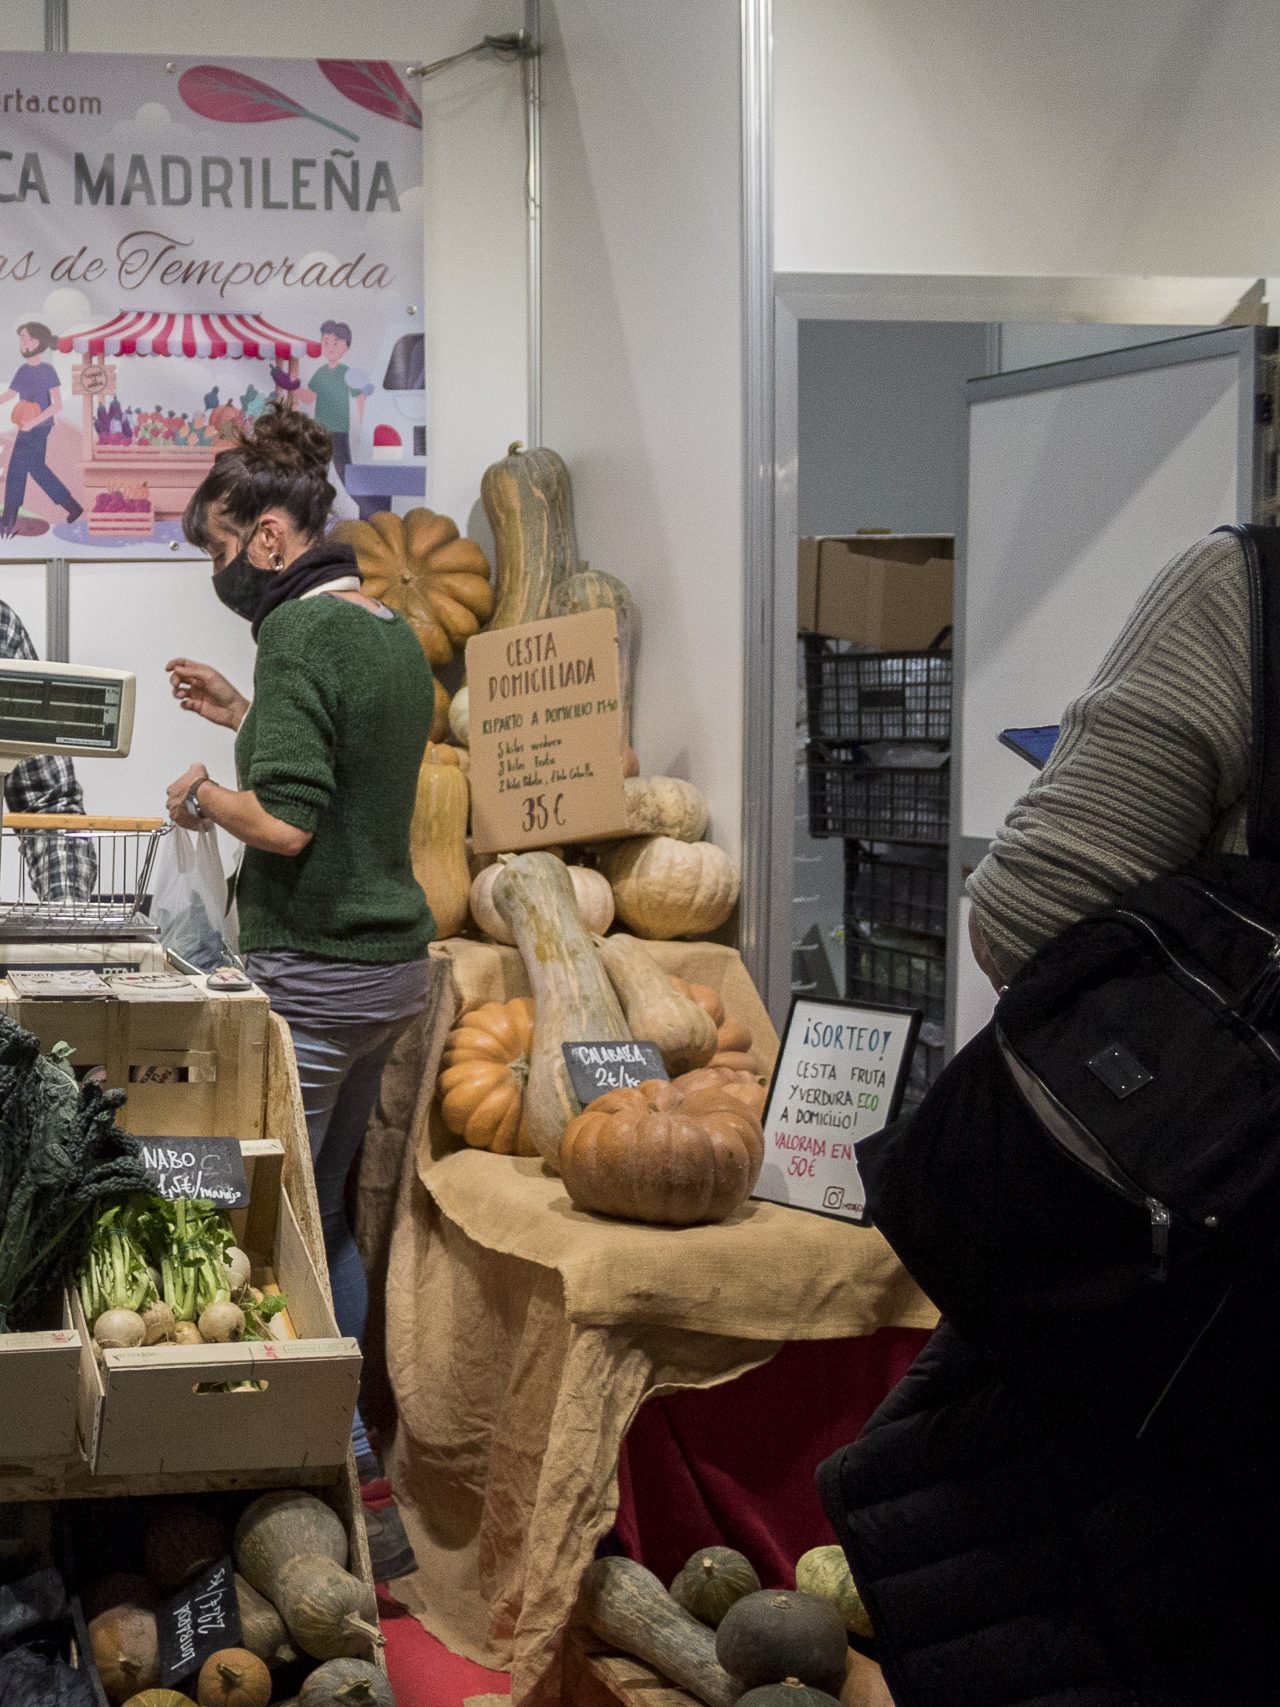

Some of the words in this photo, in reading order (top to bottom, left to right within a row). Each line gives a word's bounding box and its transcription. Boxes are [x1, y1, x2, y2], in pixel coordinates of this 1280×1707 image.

[73, 148, 401, 214] MADRILEÑA
[50, 240, 107, 284] de
[116, 230, 398, 299] Temporada
[506, 632, 557, 667] CESTA
[489, 658, 596, 702] DOMICILIADA
[803, 1017, 893, 1062] ¡SORTEO!
[578, 1044, 647, 1066] CALABAZA
[797, 1060, 837, 1081] CESTA
[851, 1066, 887, 1088] FRUTA
[780, 1109, 790, 1124] A
[857, 1092, 880, 1112] ECO
[142, 1146, 196, 1170] NABO
[774, 1131, 827, 1157] VALORADA
[830, 1143, 853, 1161] EN
[787, 1155, 817, 1178] 50€
